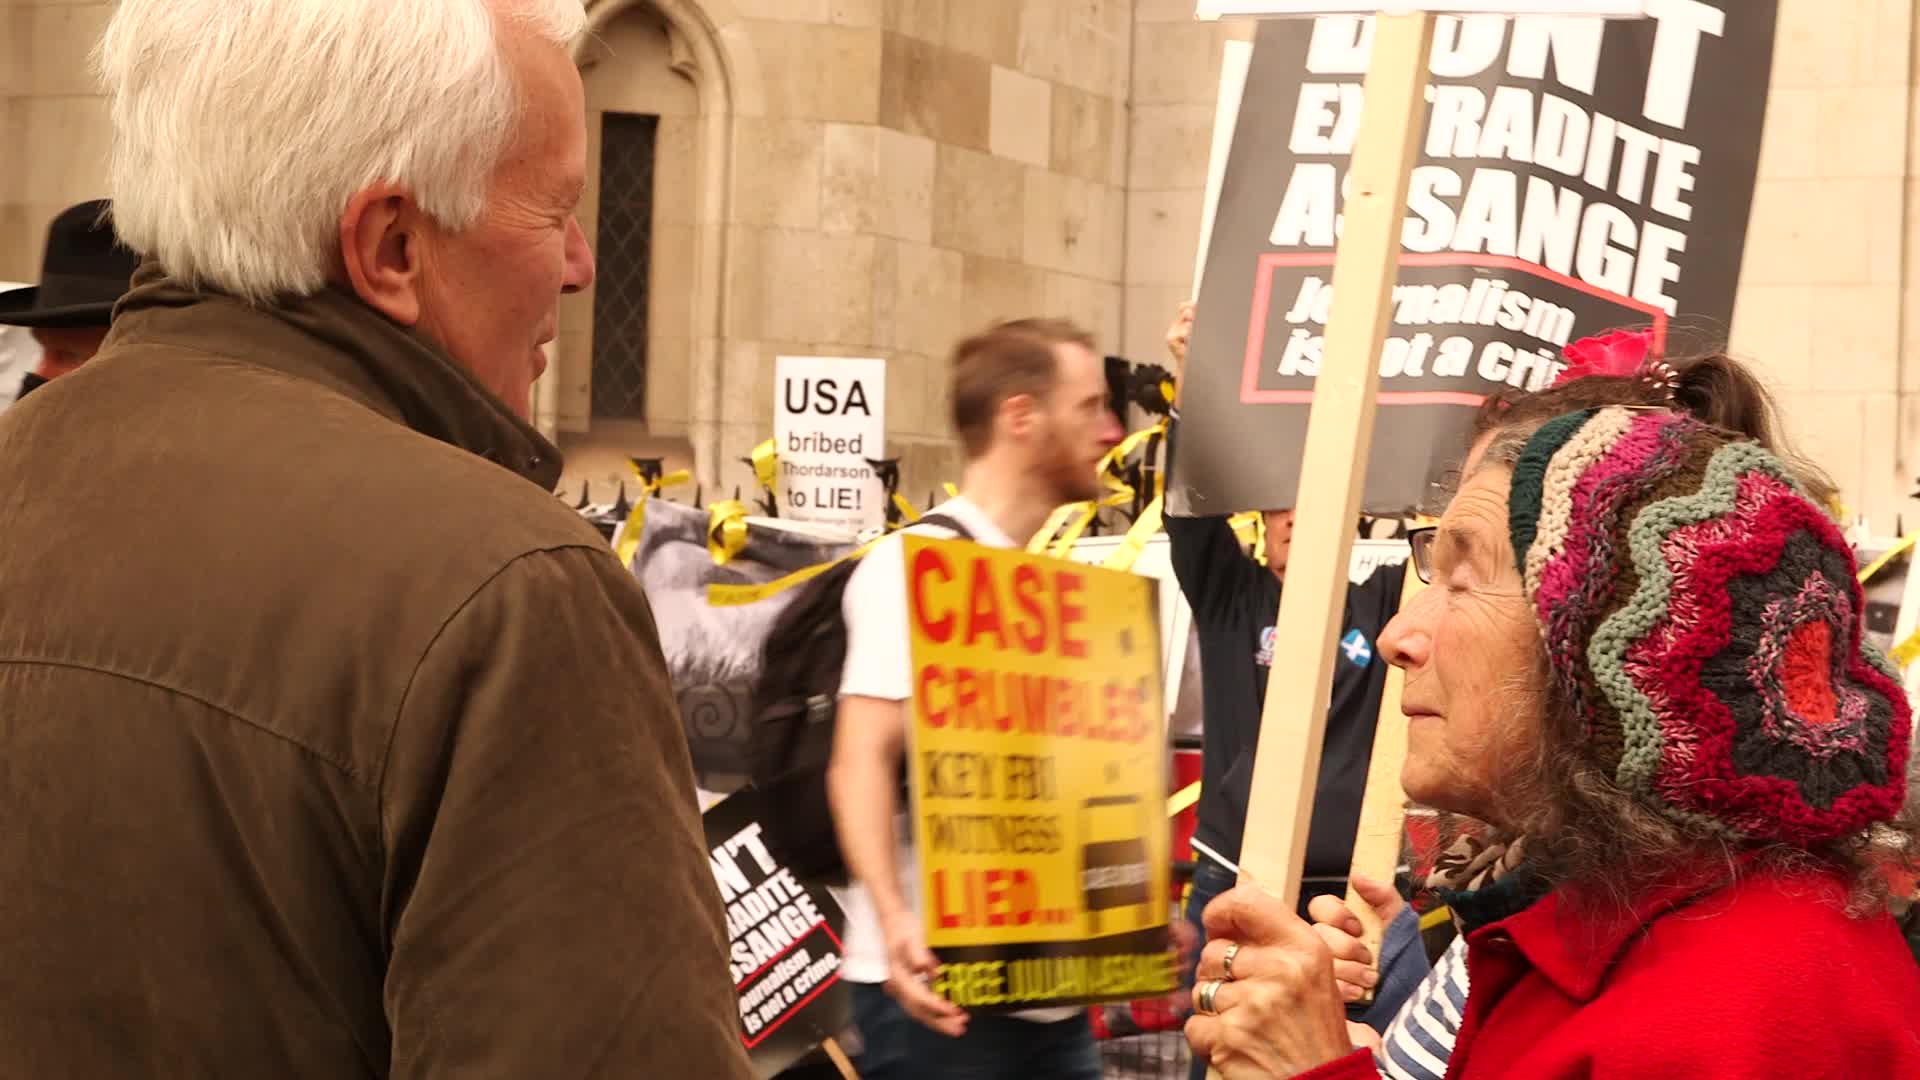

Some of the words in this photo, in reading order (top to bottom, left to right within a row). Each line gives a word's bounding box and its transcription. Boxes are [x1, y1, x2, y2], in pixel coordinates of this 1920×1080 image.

[1288, 83, 1701, 221] EXRADITE
[1269, 162, 1688, 317] ASANGE
[1286, 276, 1576, 347] Jonalism
[785, 378, 871, 416] USA
[1377, 332, 1434, 378] ot
[1431, 336, 1474, 377] a
[1477, 341, 1568, 393] cri
[782, 461, 871, 479] Thordarson
[788, 432, 863, 455] bribed
[787, 488, 807, 508] to
[815, 487, 862, 510] LIE!
[911, 546, 1089, 658] CASE
[708, 822, 778, 904] N'T
[726, 866, 804, 942] ADITE
[730, 892, 826, 985] SANGE
[739, 947, 812, 1018] ournalism
[743, 1011, 763, 1035] is
[759, 991, 788, 1024] not
[782, 984, 798, 1004] a
